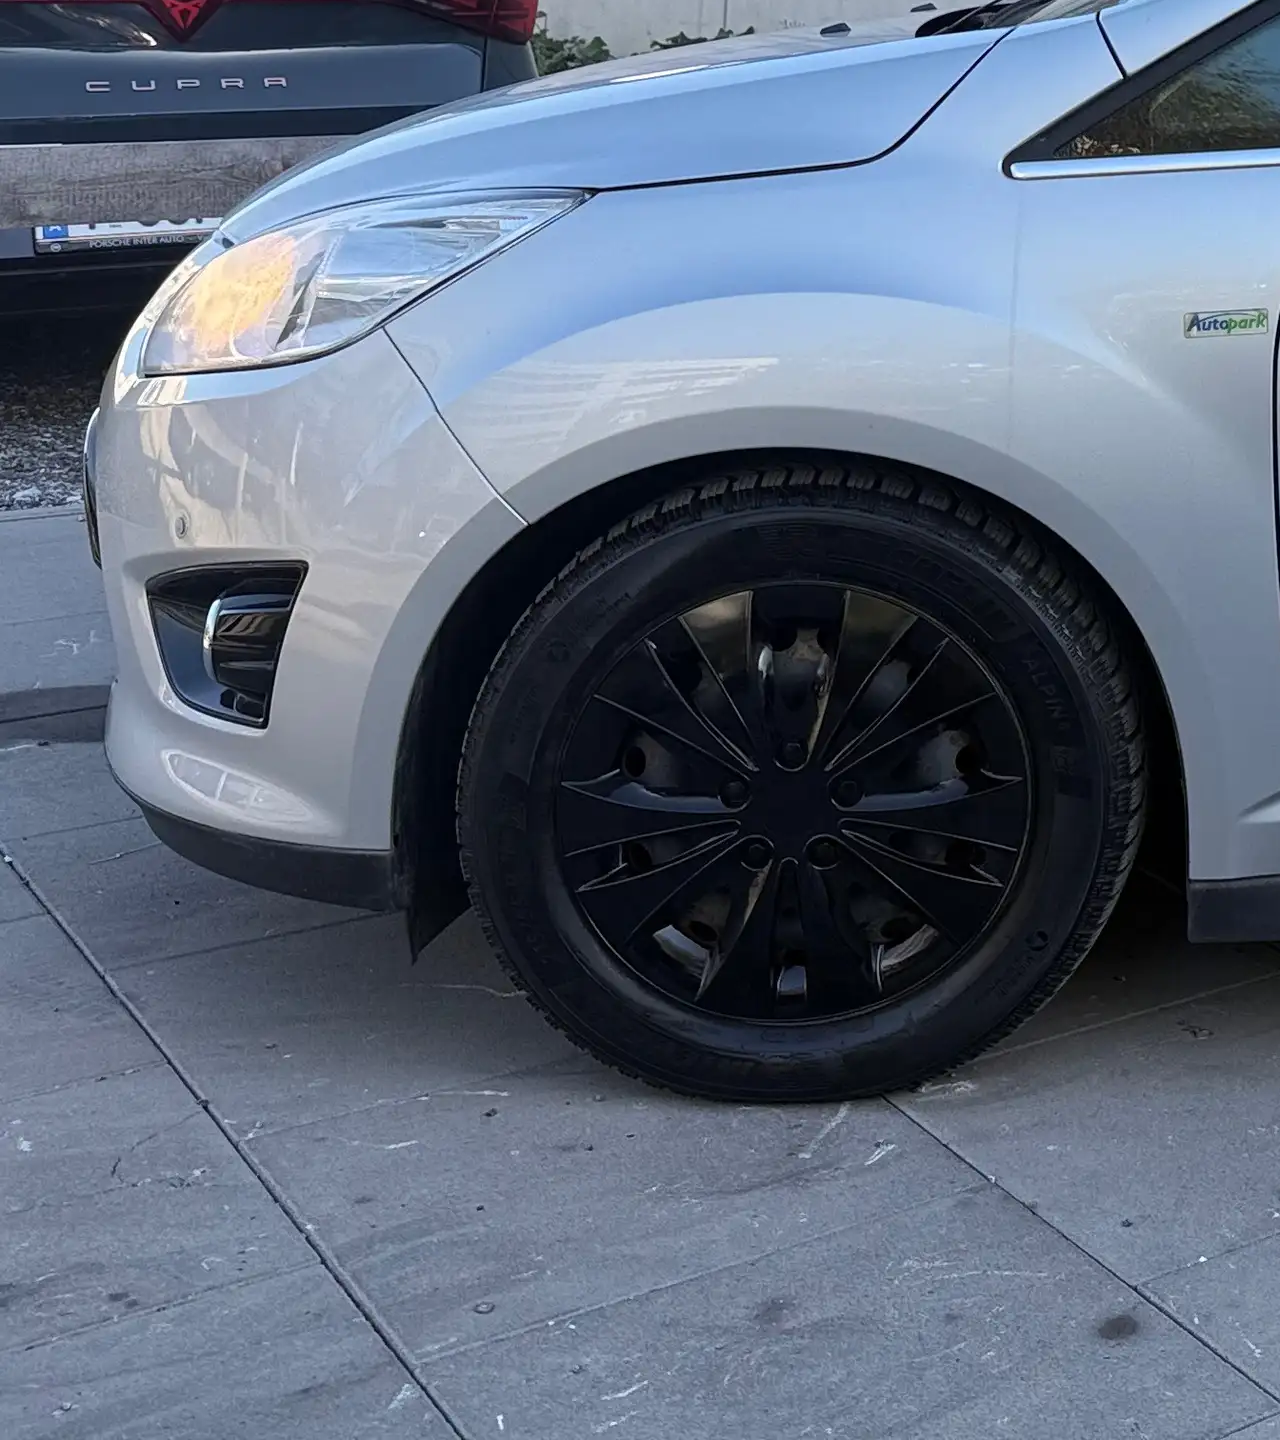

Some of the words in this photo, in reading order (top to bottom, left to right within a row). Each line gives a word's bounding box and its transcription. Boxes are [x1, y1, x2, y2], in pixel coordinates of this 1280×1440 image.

[85, 76, 288, 92] CUPRA
[89, 238, 131, 249] PORSCHE
[159, 234, 185, 244] AUTO
[1186, 312, 1267, 334] Autopark
